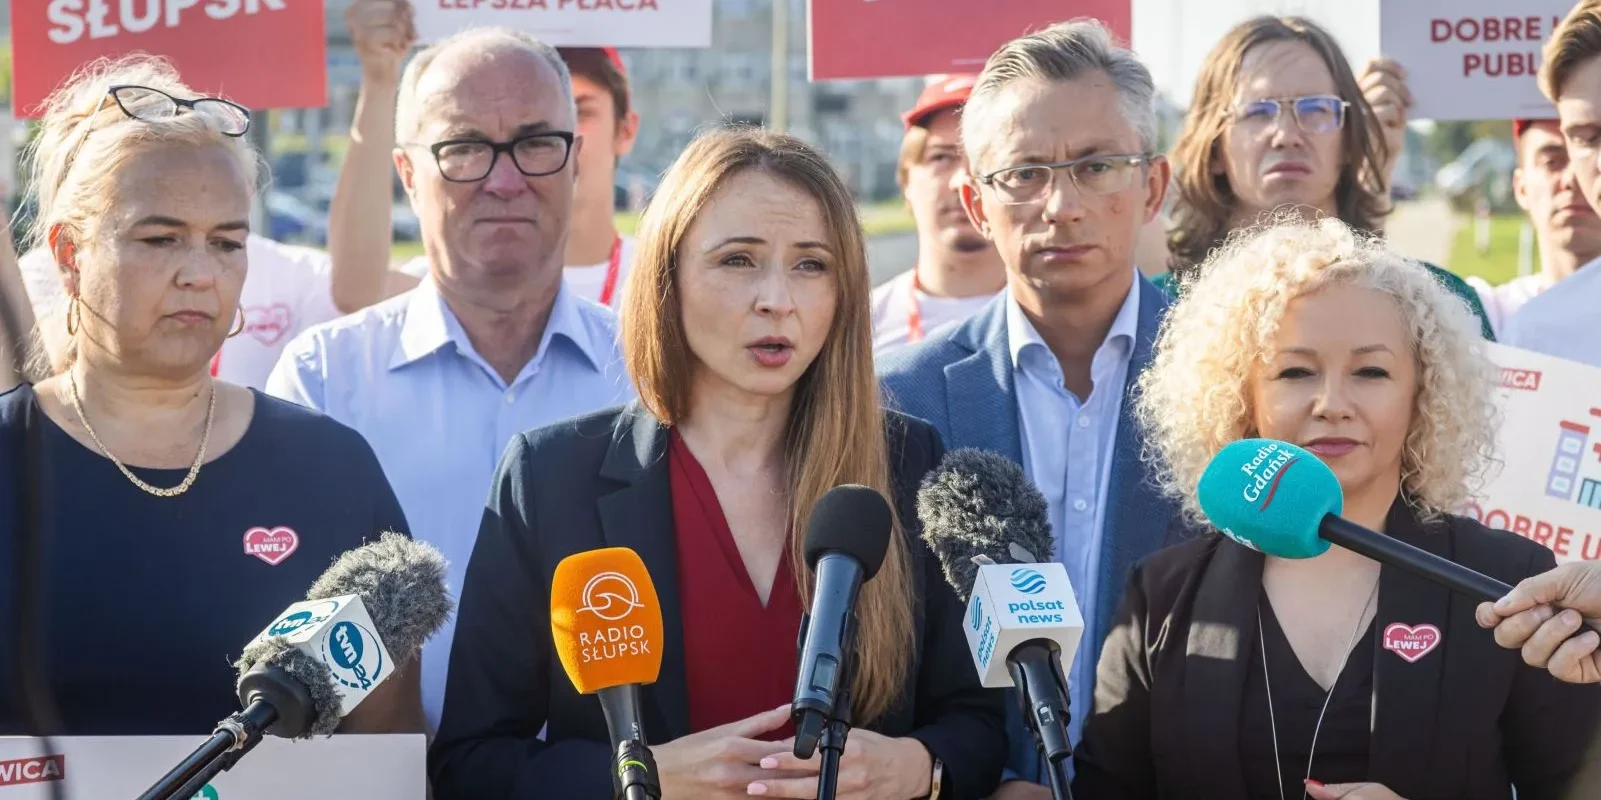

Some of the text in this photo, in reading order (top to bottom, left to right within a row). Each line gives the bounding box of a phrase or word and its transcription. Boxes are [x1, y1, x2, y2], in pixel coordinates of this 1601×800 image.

[1430, 16, 1542, 43] DOBRE
[1241, 443, 1278, 476] Radio
[1243, 449, 1295, 502] Gdańsk
[246, 542, 286, 552] LEWEJ
[1008, 600, 1065, 613] polsat
[1018, 614, 1063, 623] news
[580, 625, 644, 647] RADIO
[978, 615, 991, 662] polsat
[1386, 637, 1427, 650] LEWEJ
[582, 639, 651, 663] SŁUPSK
